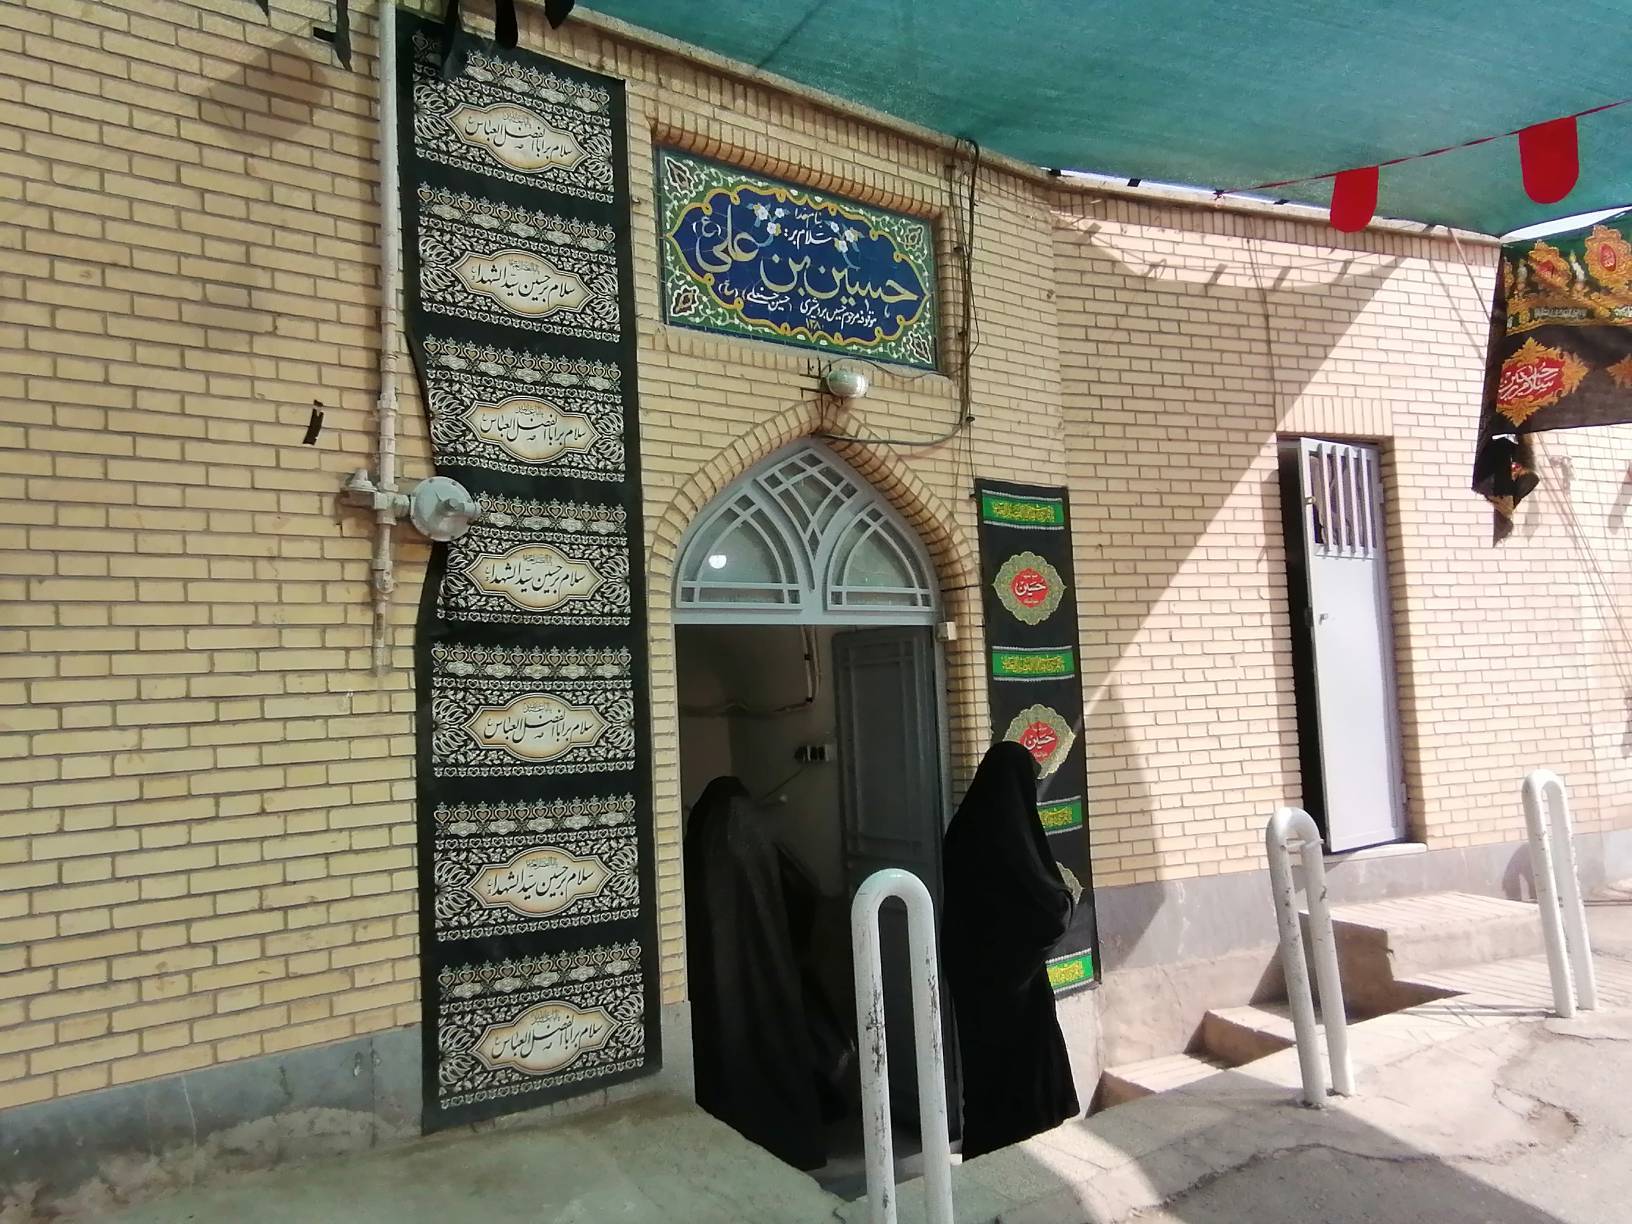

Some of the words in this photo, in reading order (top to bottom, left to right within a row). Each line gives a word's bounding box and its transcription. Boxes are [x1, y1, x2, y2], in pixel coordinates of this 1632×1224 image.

[550, 144, 572, 158] سلام
[695, 204, 760, 273] علی
[796, 229, 832, 250] سلام
[760, 253, 812, 297] بن
[519, 275, 551, 300] حسین
[549, 282, 575, 302] سلام
[804, 265, 920, 307] حسین
[565, 426, 586, 441] سلام
[532, 565, 563, 593] حسین
[559, 571, 585, 592] سلام
[1015, 579, 1046, 596] حسین
[571, 721, 593, 736] سلام
[1023, 731, 1056, 751] حسین
[536, 866, 567, 897] حسین
[566, 867, 594, 889] سلام
[580, 1023, 602, 1039] سلام
